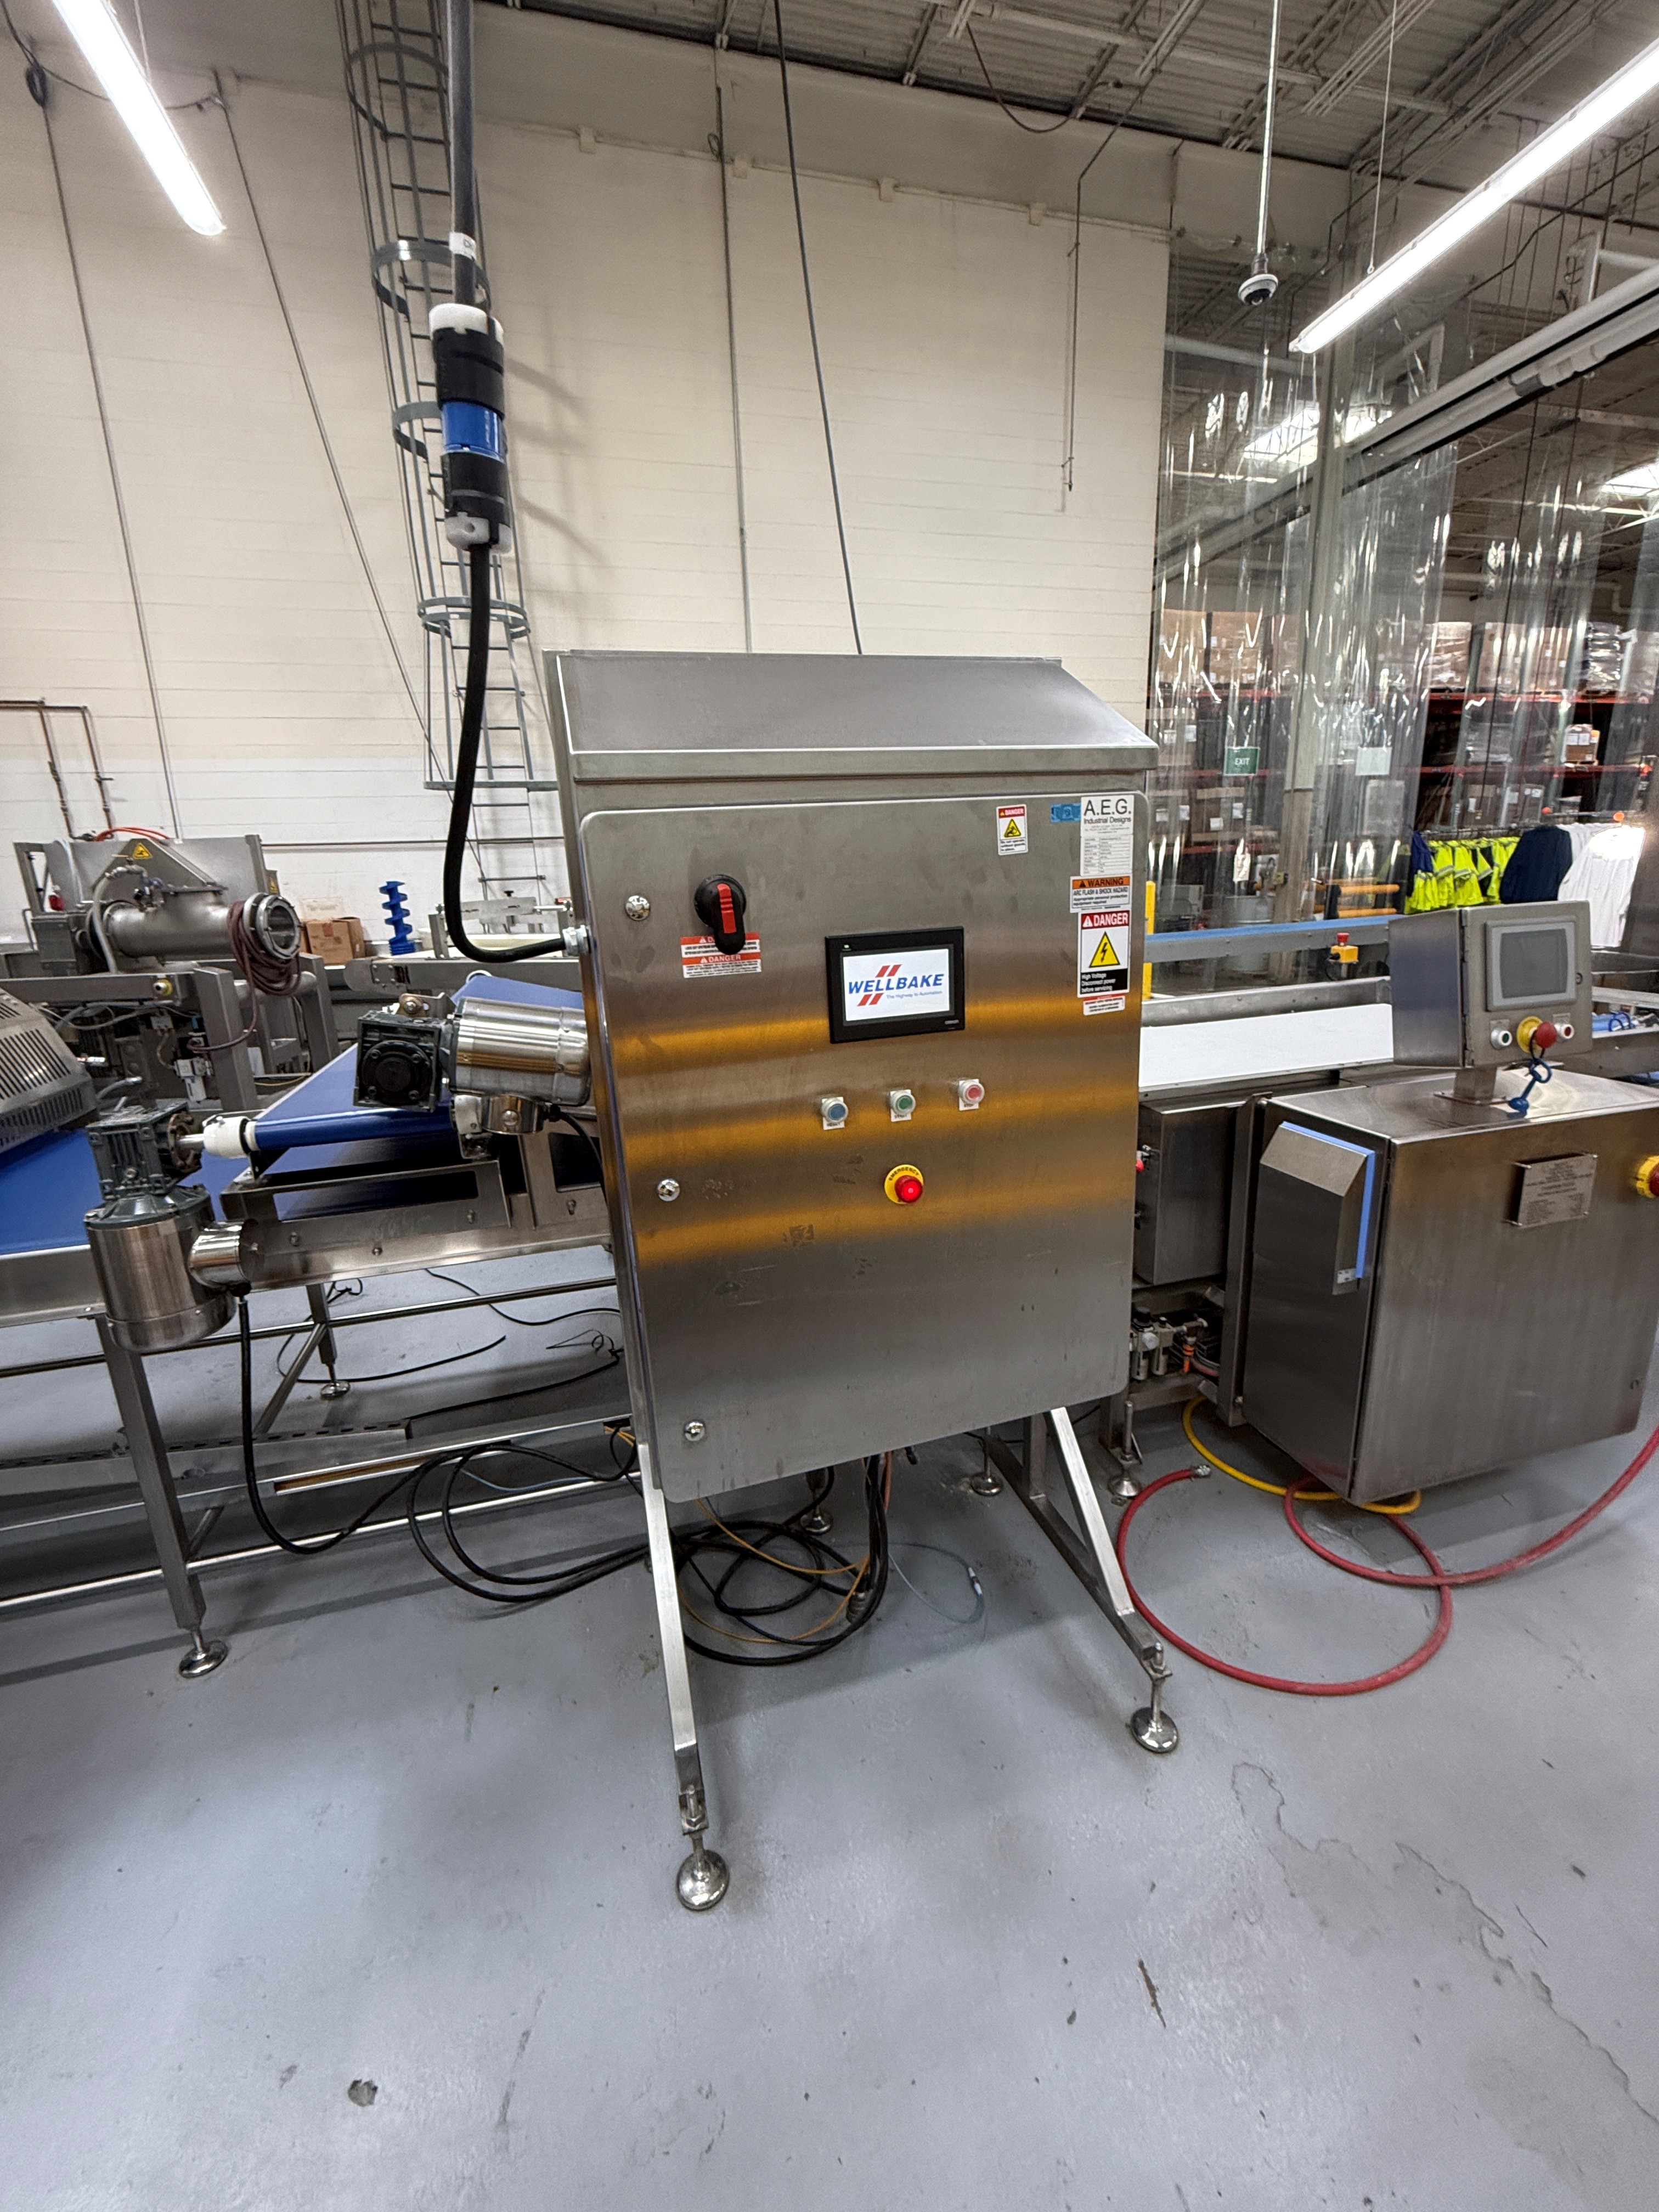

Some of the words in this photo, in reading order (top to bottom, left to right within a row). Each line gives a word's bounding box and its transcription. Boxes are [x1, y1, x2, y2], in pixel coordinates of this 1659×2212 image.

[1084, 799, 1132, 816] A.E.G.
[1088, 877, 1124, 887] WARNING
[1093, 912, 1128, 927] DANGER
[708, 955, 741, 963] DANGER
[849, 974, 944, 994] WELLBAKE
[889, 1166, 919, 1181] EMERGENCY
